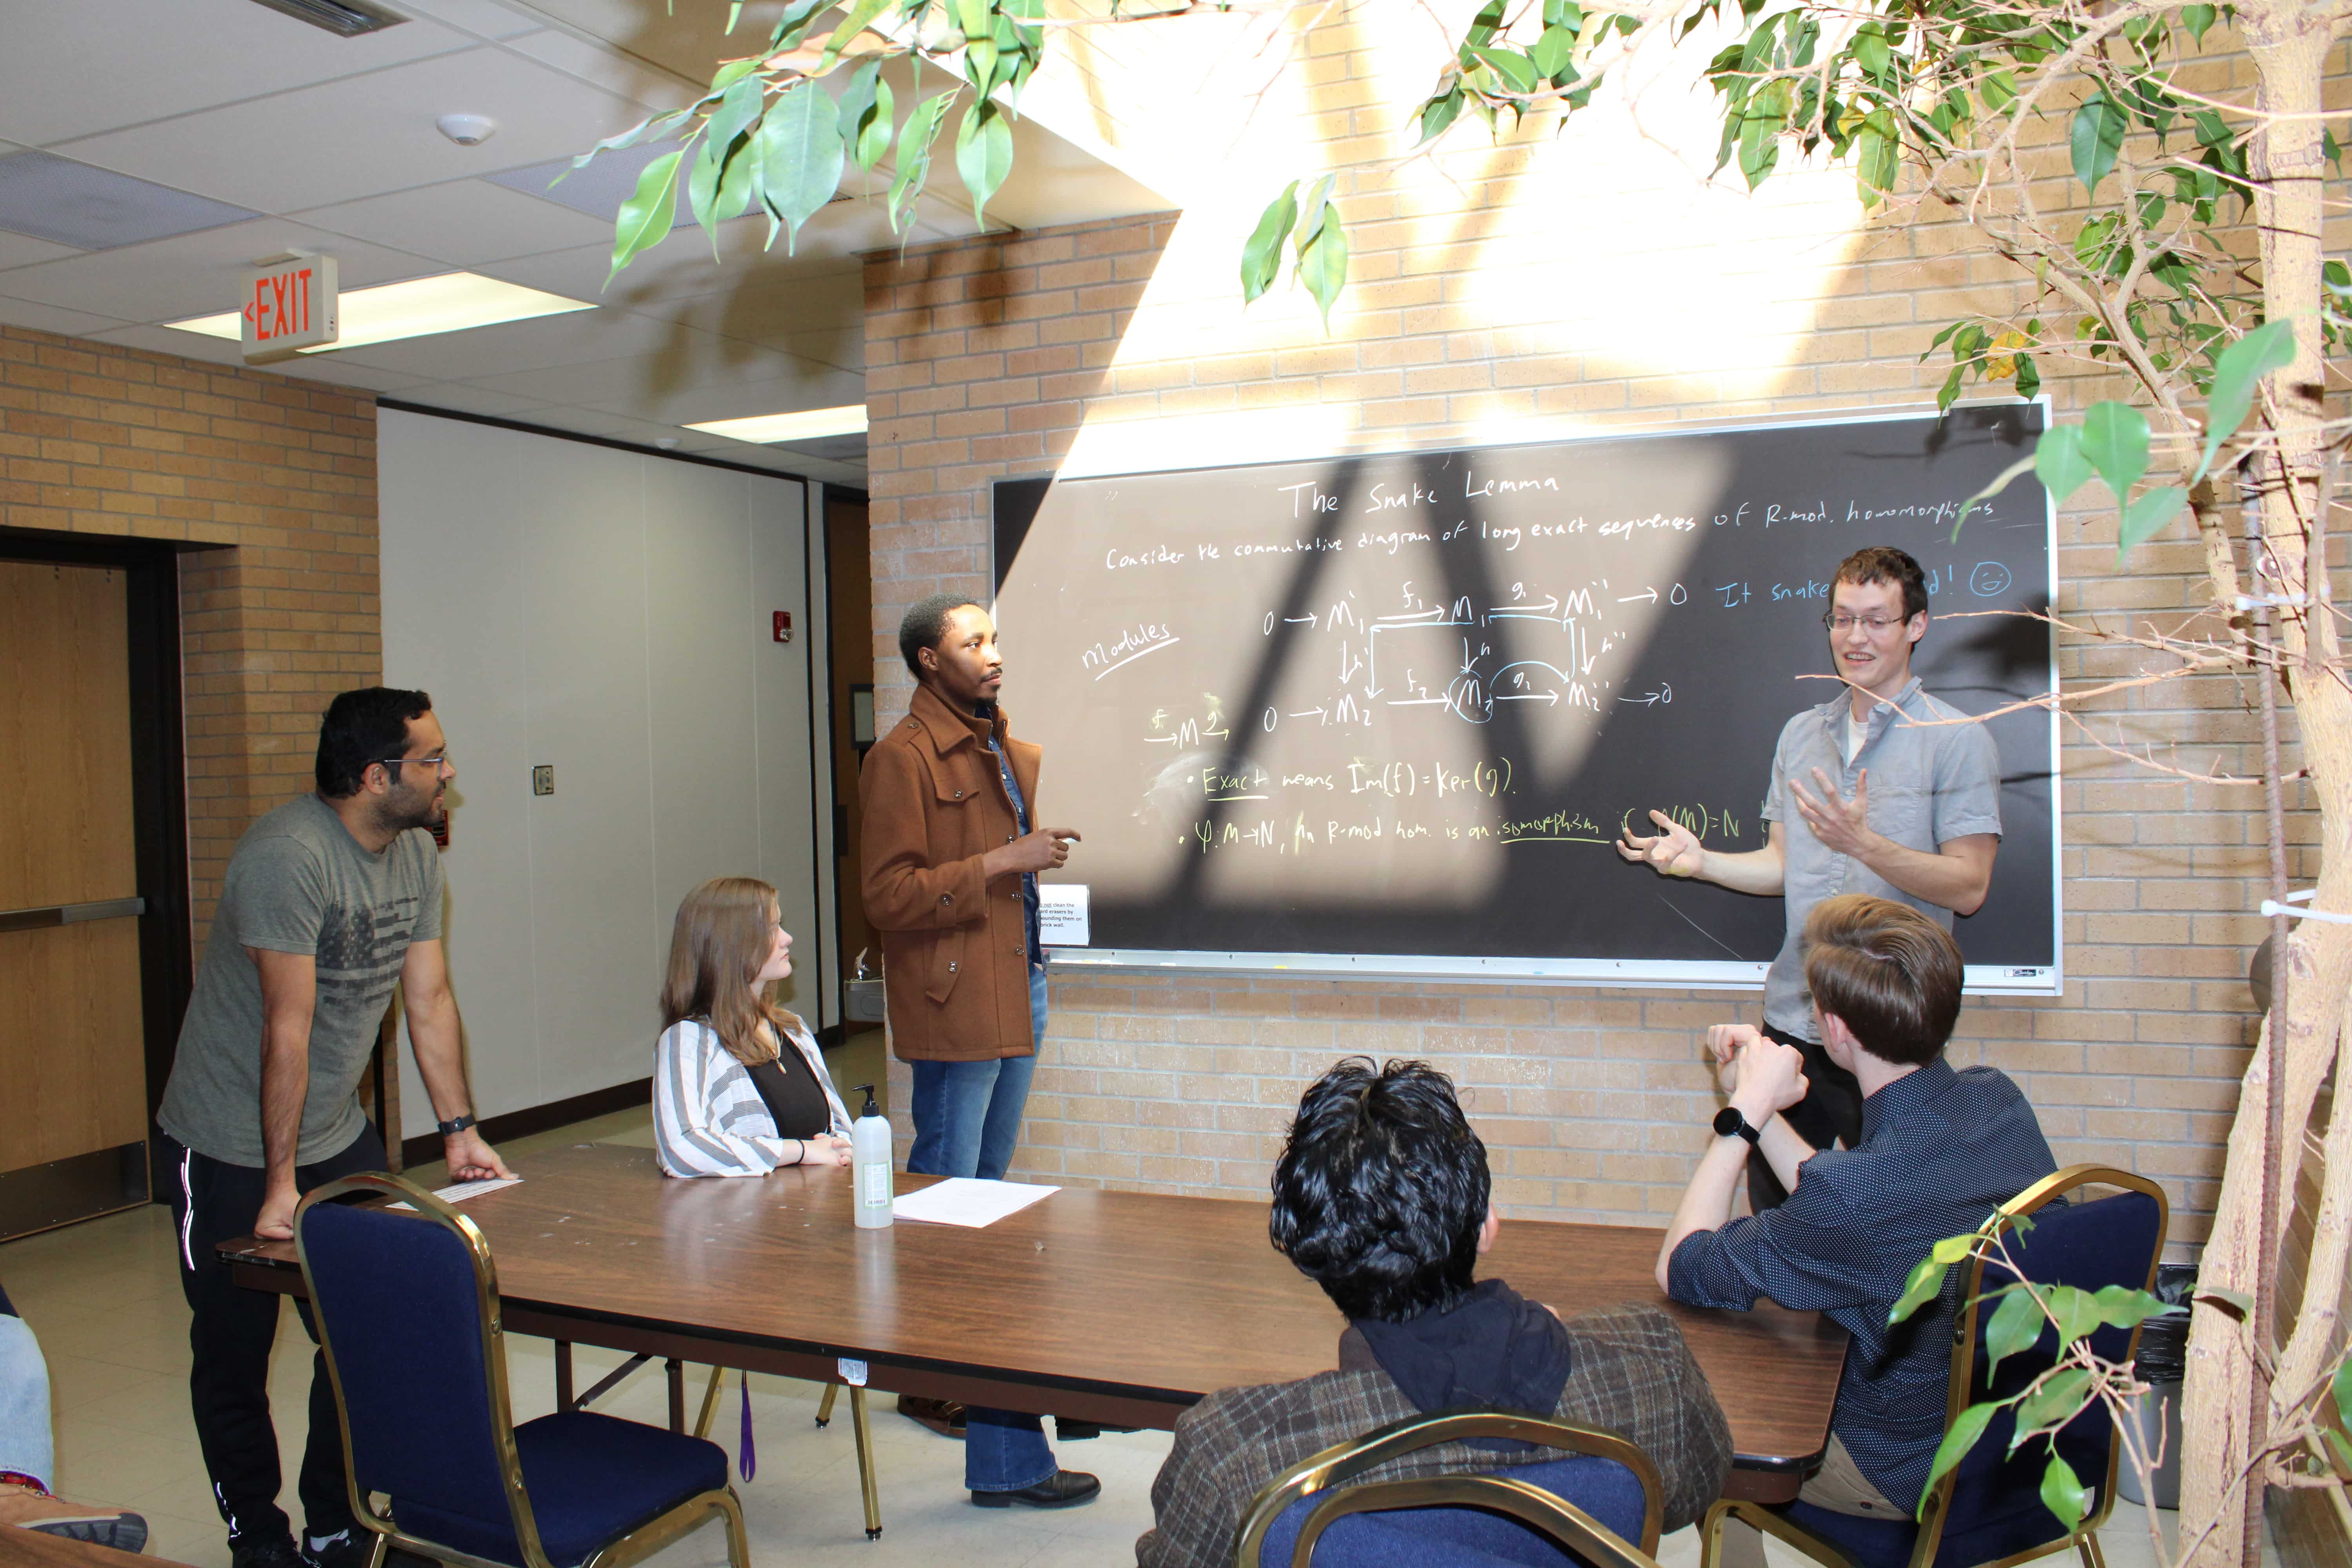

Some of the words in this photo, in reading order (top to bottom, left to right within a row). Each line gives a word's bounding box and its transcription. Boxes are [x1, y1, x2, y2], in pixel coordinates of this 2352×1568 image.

[256, 268, 311, 341] EXIT
[1278, 481, 1339, 517] The
[1366, 483, 1438, 513] Snake
[1466, 470, 1559, 498] Lemma
[1107, 544, 1185, 569] Consider
[1198, 543, 1220, 561] the
[1234, 537, 1343, 557] commutative
[1357, 532, 1431, 555] diagram
[1443, 520, 1468, 540] of
[1482, 520, 1521, 550] long
[1531, 516, 1588, 536] exact
[1598, 513, 1696, 541] sequences
[1714, 503, 1749, 526] of
[1716, 581, 1751, 607] It
[1203, 767, 1268, 795] Exact
[1282, 773, 1335, 790] means
[1445, 819, 1459, 840] is
[1468, 826, 1490, 840] an
